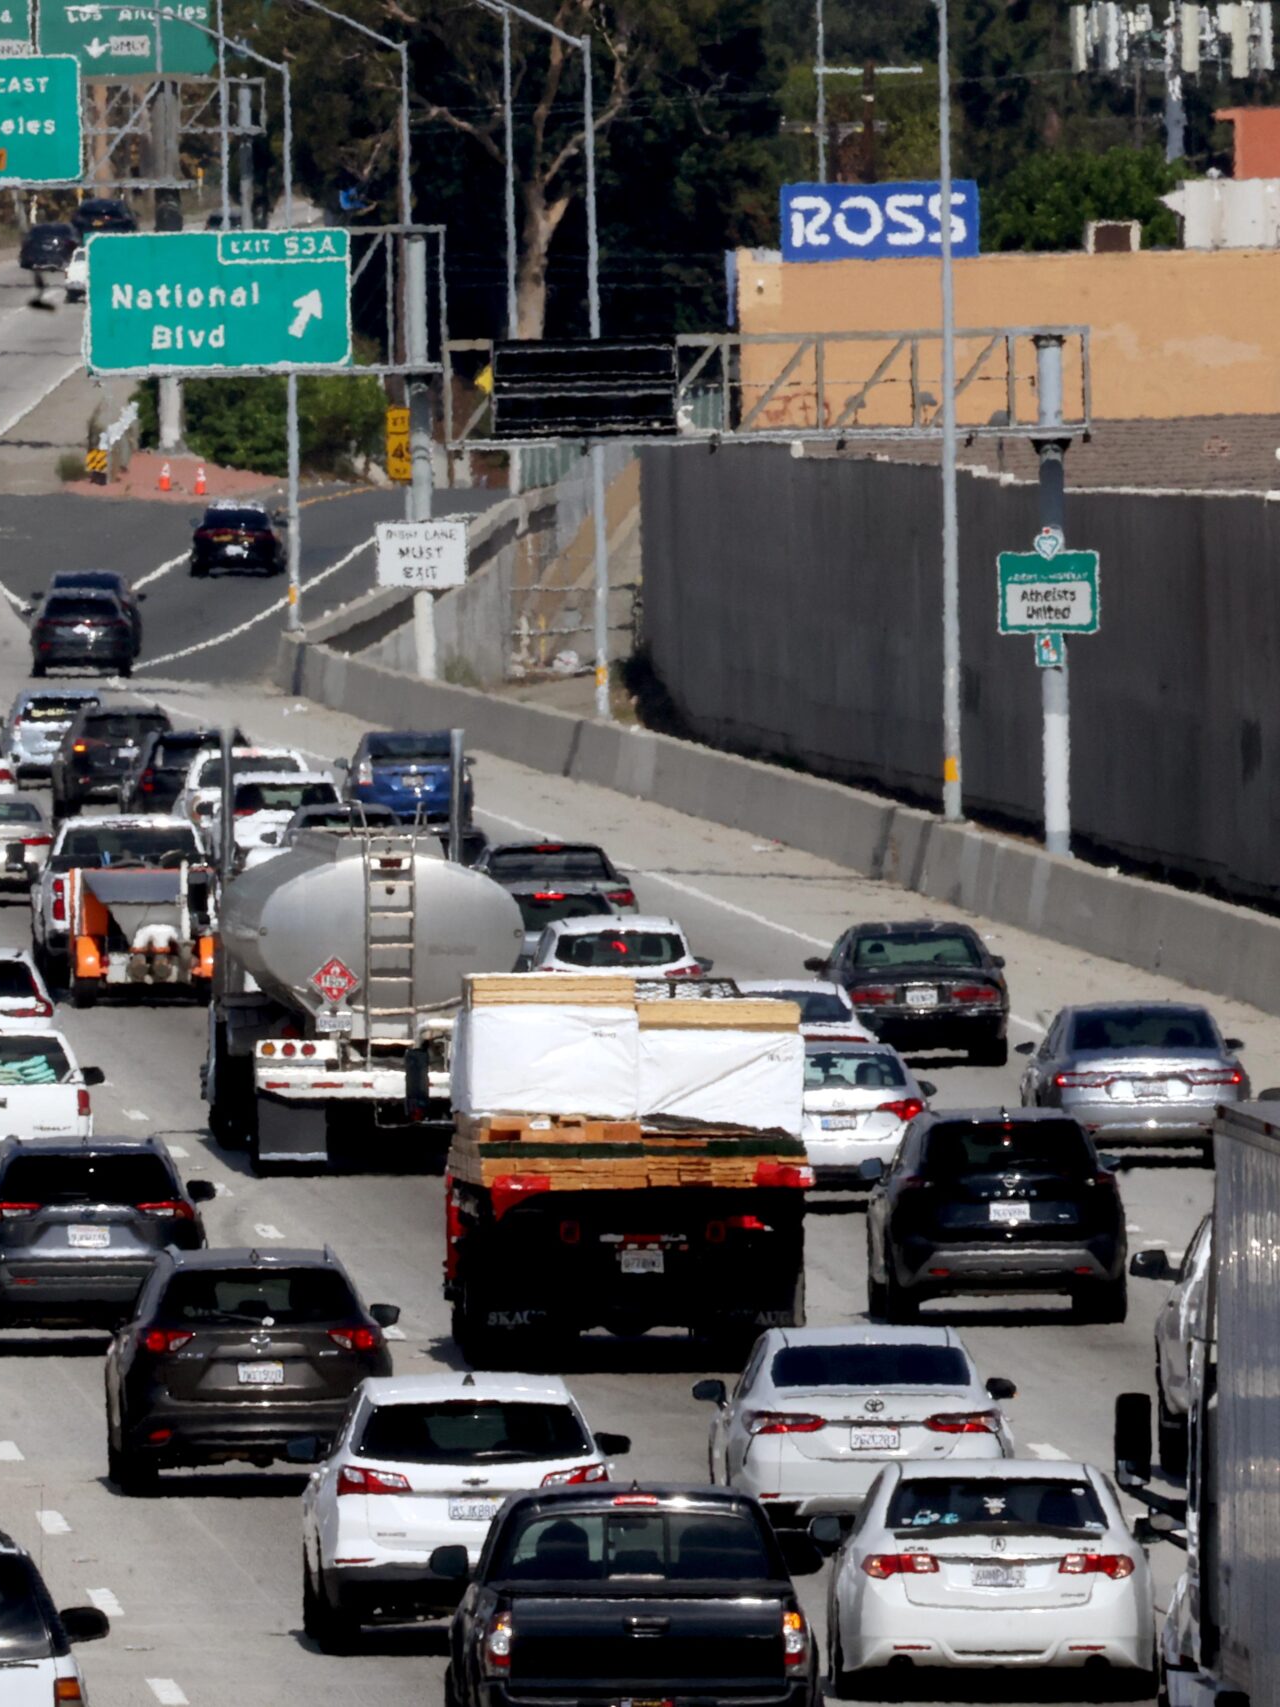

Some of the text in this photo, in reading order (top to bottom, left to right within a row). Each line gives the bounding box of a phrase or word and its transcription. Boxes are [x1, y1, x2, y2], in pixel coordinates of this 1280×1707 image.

[789, 193, 968, 247] ROSS
[231, 236, 337, 256] EXIT 53A
[112, 282, 260, 309] National
[151, 324, 226, 350] Blvd
[424, 528, 457, 541] LANE
[398, 546, 443, 560] MUST
[402, 566, 439, 580] EXIT
[1020, 588, 1077, 603] Atheists
[1026, 605, 1072, 620] United
